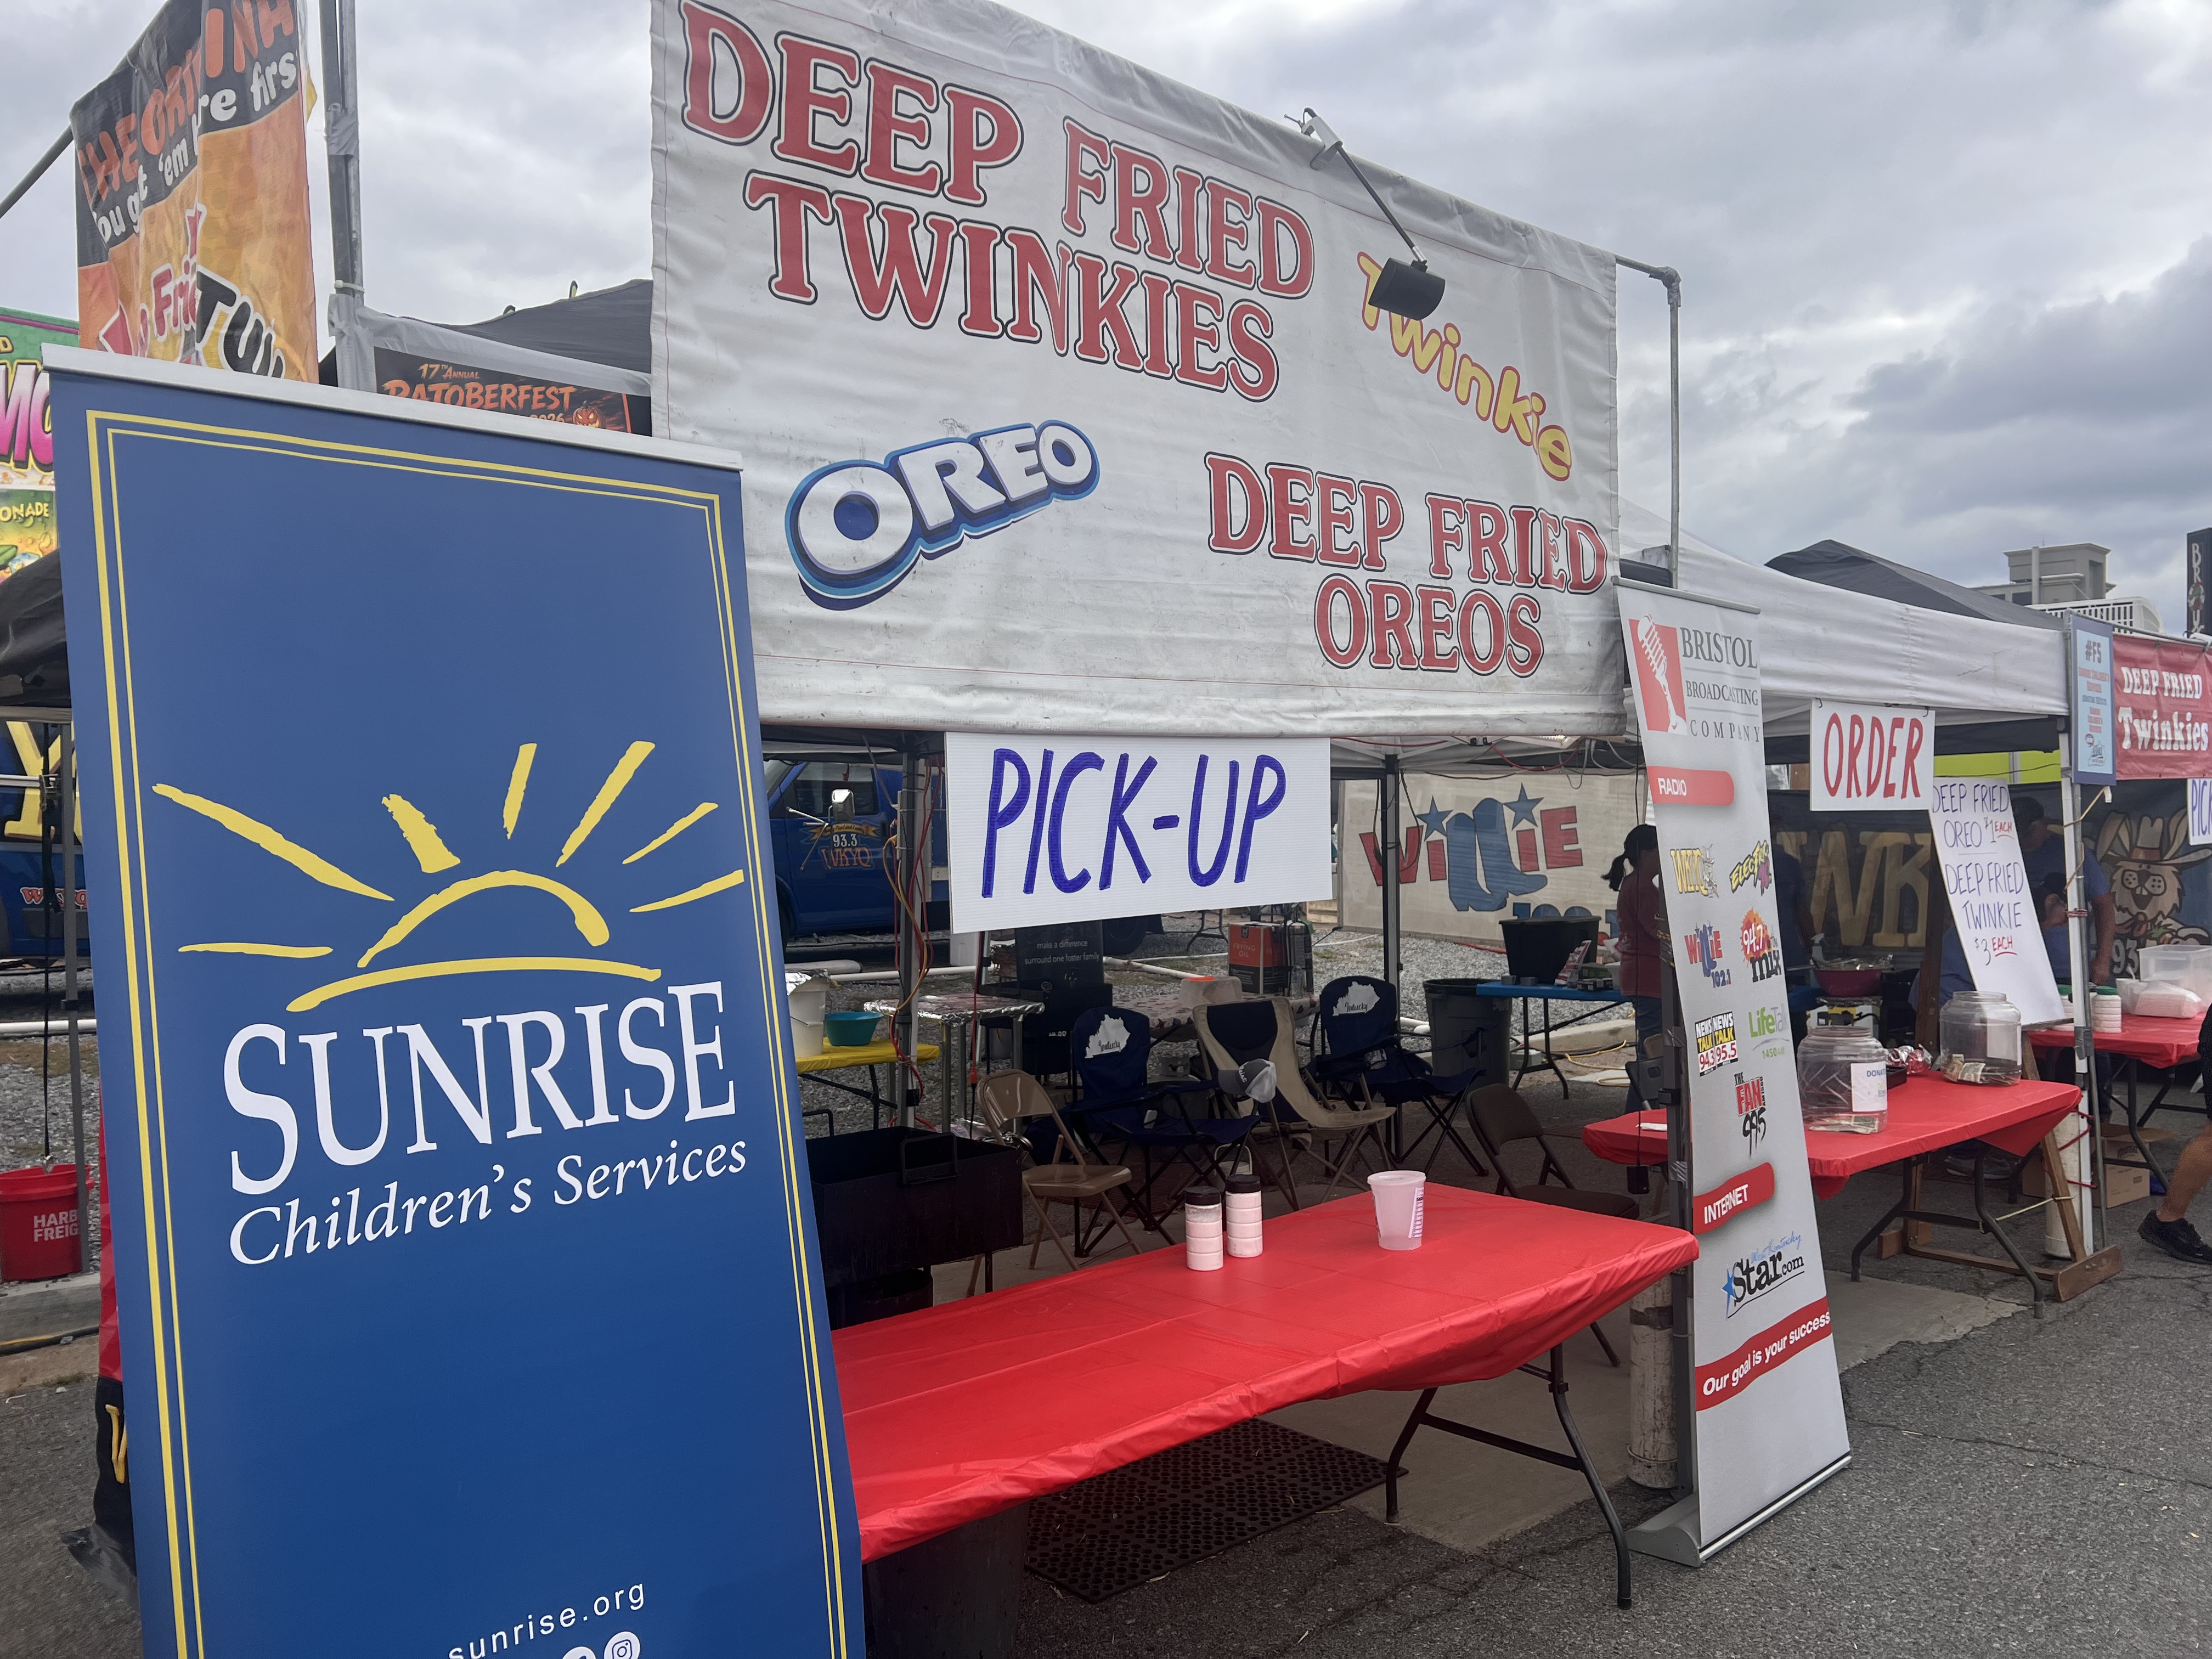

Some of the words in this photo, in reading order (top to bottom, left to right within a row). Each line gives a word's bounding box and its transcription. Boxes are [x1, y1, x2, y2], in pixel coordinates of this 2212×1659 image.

[250, 52, 297, 112] firs
[679, 0, 1023, 206] DEEP
[1062, 116, 1314, 299] FRIED
[743, 169, 1279, 402] TWINKIES
[793, 421, 1096, 590] OREO
[1204, 452, 1403, 572] DEEP
[1425, 493, 1607, 595] FRIED
[1315, 573, 1544, 678] OREOS
[1679, 627, 1758, 669] BRISTOL
[1685, 680, 1759, 706] BROADCASTING
[2121, 666, 2160, 696] DEEP
[2162, 671, 2203, 699] FRIED
[1690, 719, 1760, 742] COMPANY
[2118, 706, 2209, 751] Twinkies
[1824, 713, 1925, 799] ORDER
[1657, 777, 1688, 797] RADIO
[1932, 783, 1967, 814] DEEP
[1973, 783, 2009, 813] FRIED
[981, 748, 1286, 899] PICK-UP
[1944, 820, 1982, 848] OREO
[1994, 821, 2012, 832] EACH
[832, 833, 857, 848] 93.3
[1945, 862, 1984, 896] DEEP
[1987, 862, 2024, 894] FRIED
[1962, 900, 2022, 930] TWINKIE
[1233, 943, 1256, 951] FRYING
[1743, 922, 1763, 955] 94.7
[1991, 935, 2013, 952] EACH
[1750, 950, 1782, 983] mix
[1695, 1019, 1712, 1039] NEWS
[1712, 1012, 1734, 1032] NEWS
[1714, 1026, 1734, 1045] TALK
[1697, 1034, 1713, 1053] TALK
[1716, 1042, 1737, 1063] 95.5
[223, 980, 736, 1195] SUNRISE
[1736, 1078, 1763, 1115] FAN
[229, 1163, 532, 1266] Children's
[553, 1138, 747, 1205] Services
[1703, 1183, 1749, 1224] INTERNET
[33, 1222, 78, 1243] FREIG
[1733, 1251, 1805, 1307] Star.com
[1703, 1373, 1730, 1396] Our
[1731, 1353, 1751, 1387] goal
[1752, 1350, 1762, 1367] is
[1764, 1334, 1788, 1364] your
[1788, 1310, 1831, 1345] success
[448, 1583, 645, 1659] sunrise.org
